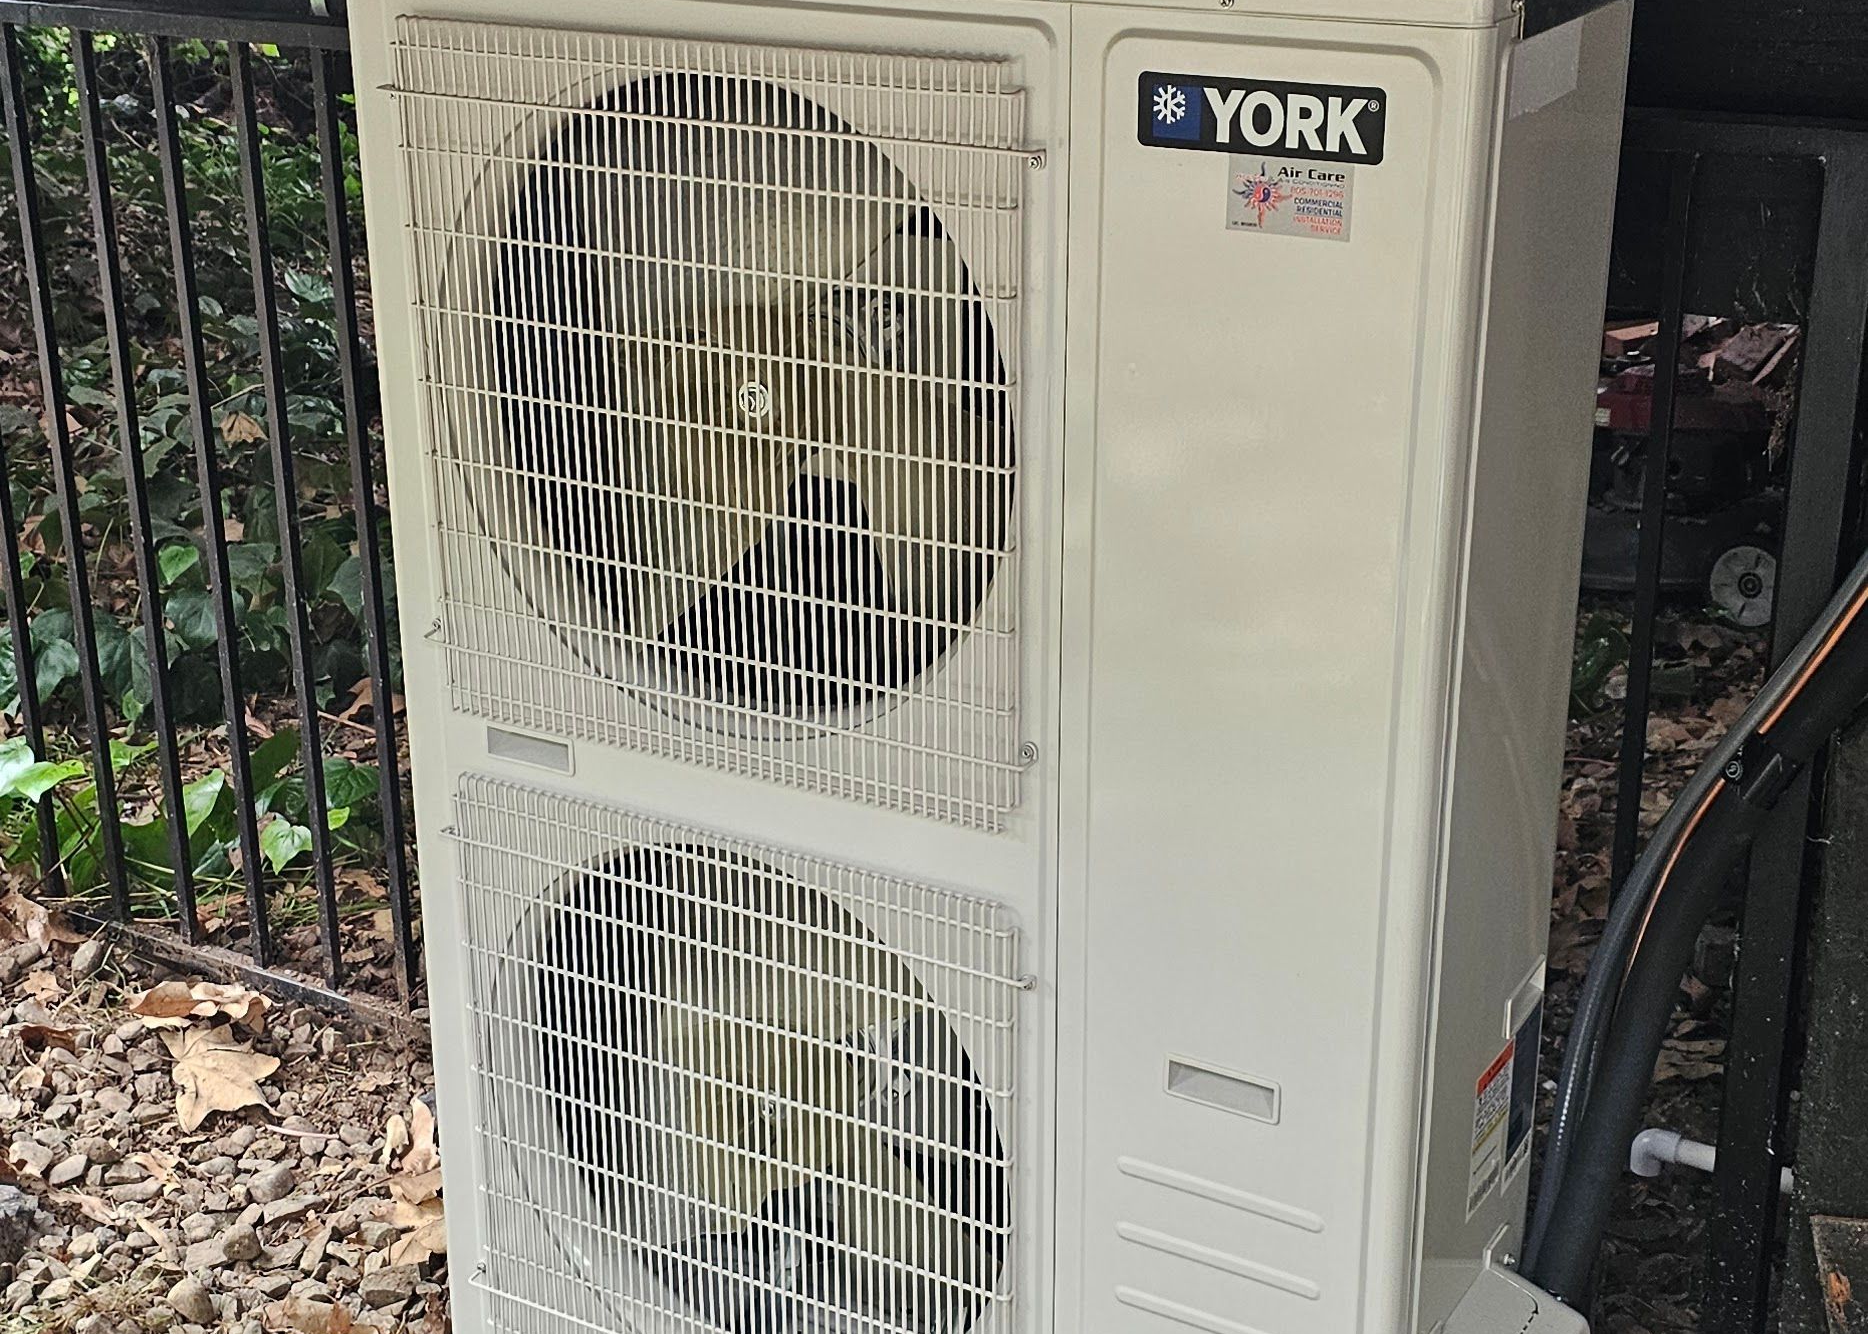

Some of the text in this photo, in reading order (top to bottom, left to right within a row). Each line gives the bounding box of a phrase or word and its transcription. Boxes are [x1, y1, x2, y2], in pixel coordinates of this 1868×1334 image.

[1277, 167, 1302, 178] Air
[1308, 169, 1345, 182] Care
[1294, 197, 1343, 209] COMMERCIAL
[1296, 205, 1343, 217] RESIDENTIAL
